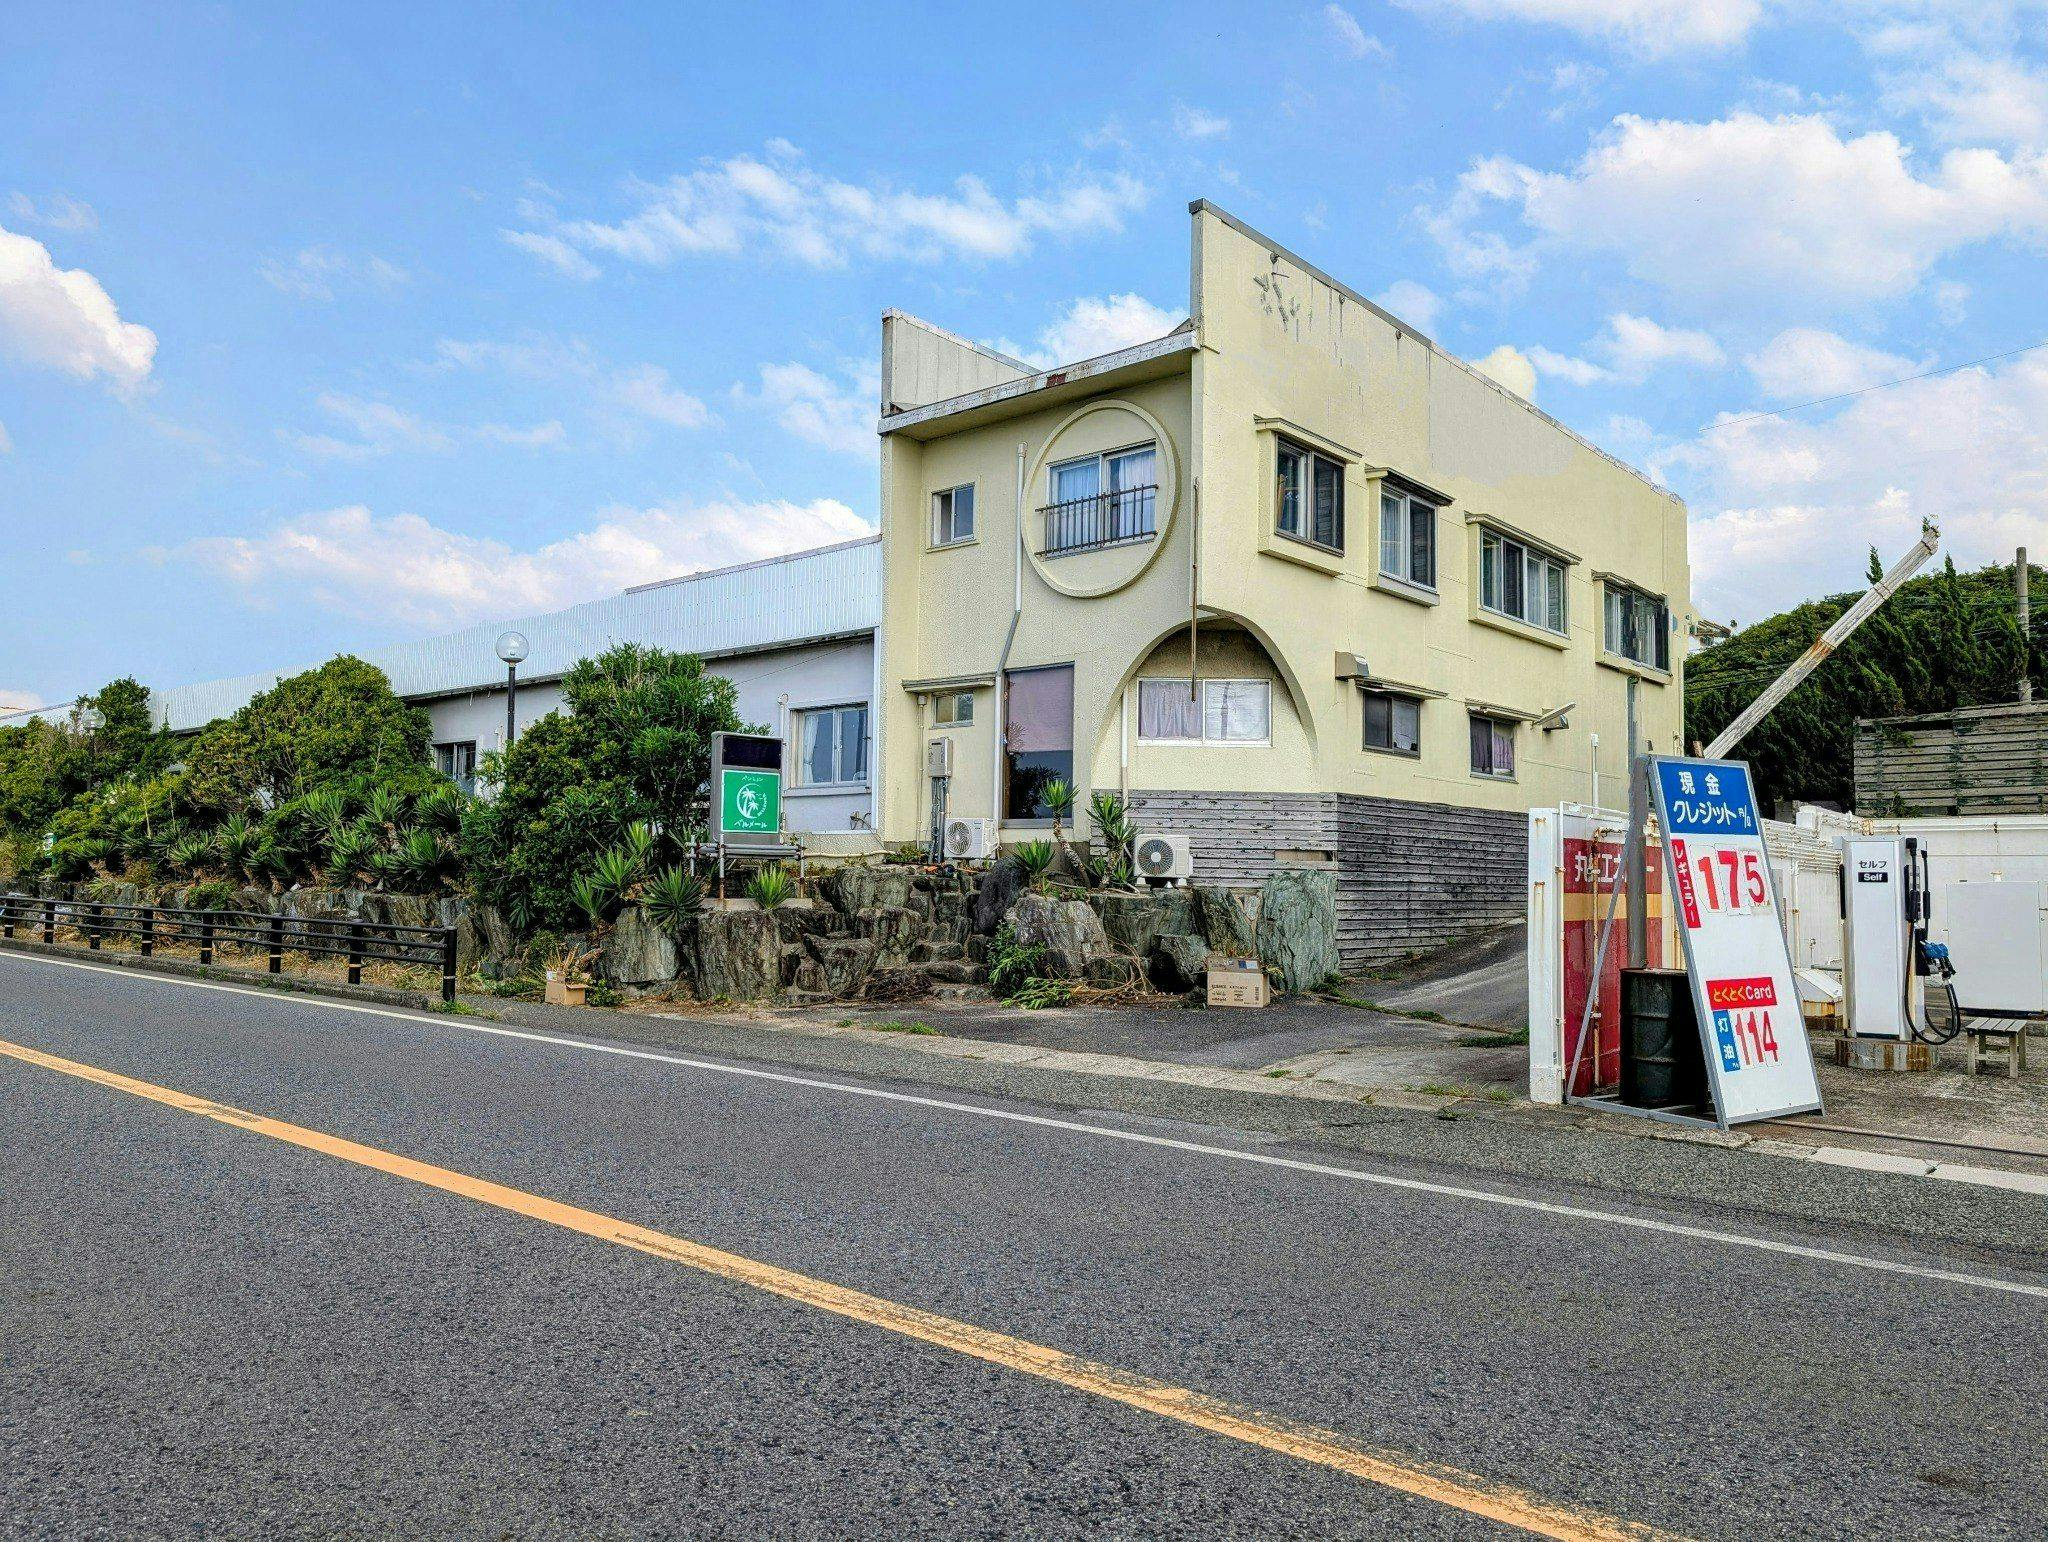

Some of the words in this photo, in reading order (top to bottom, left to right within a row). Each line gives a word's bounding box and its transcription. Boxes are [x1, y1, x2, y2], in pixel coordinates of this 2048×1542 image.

[1673, 800, 1737, 826] クレジット
[1674, 844, 1696, 923] レギュラー
[1697, 850, 1766, 910] 175
[1858, 860, 1888, 869] セルフ
[1863, 873, 1883, 882] Self
[1717, 1017, 1736, 1060] 灯油
[1735, 1011, 1779, 1066] 114
